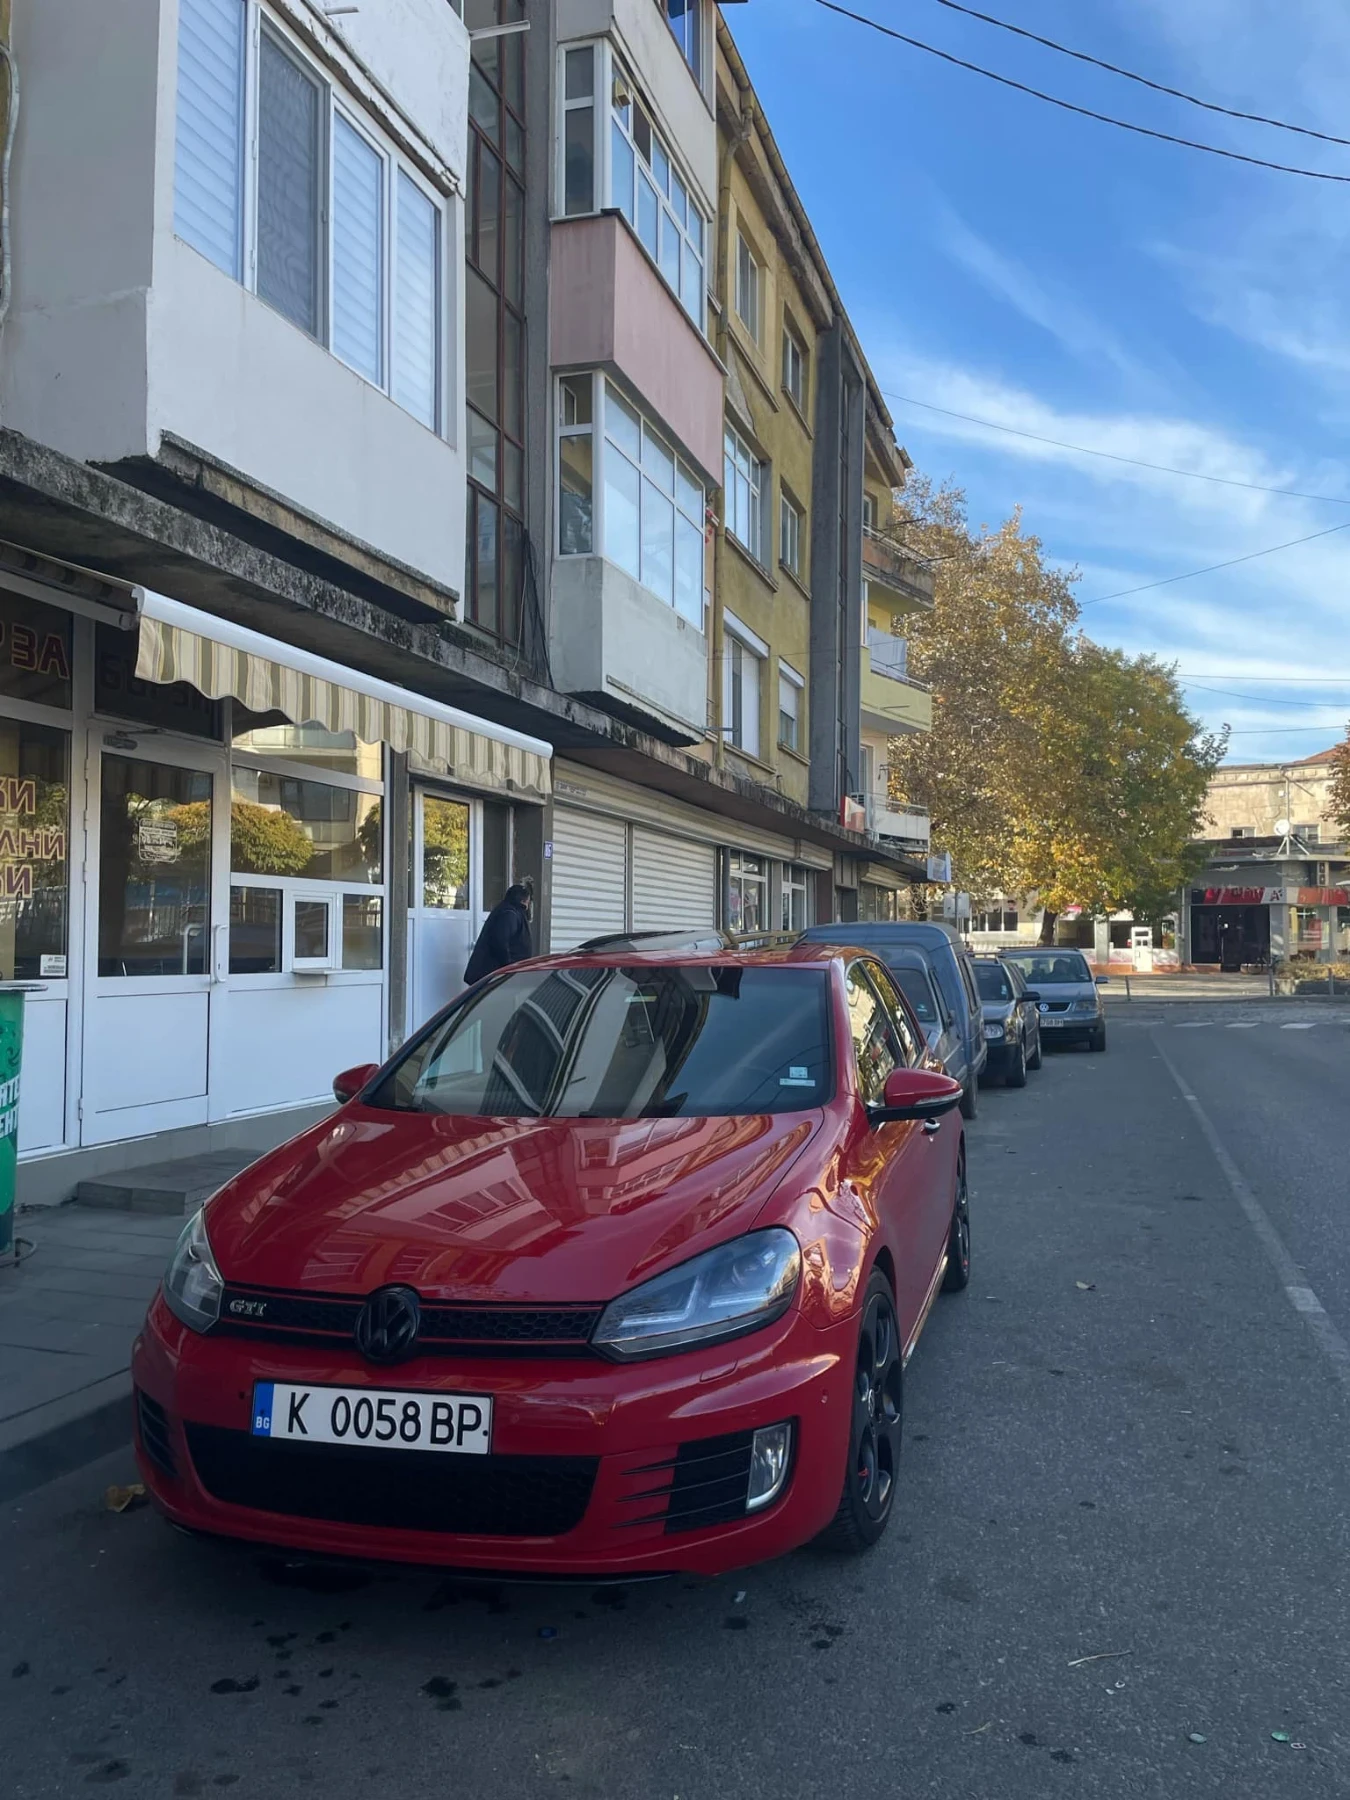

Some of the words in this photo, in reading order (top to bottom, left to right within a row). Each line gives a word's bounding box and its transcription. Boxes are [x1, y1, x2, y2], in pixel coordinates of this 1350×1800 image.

[0, 620, 70, 680] ЗА
[0, 776, 36, 815] И
[0, 863, 32, 898] И
[229, 1299, 267, 1317] GTI
[255, 1416, 270, 1430] BG
[287, 1391, 311, 1435] K
[331, 1396, 422, 1443] 0058
[430, 1402, 482, 1446] BP
